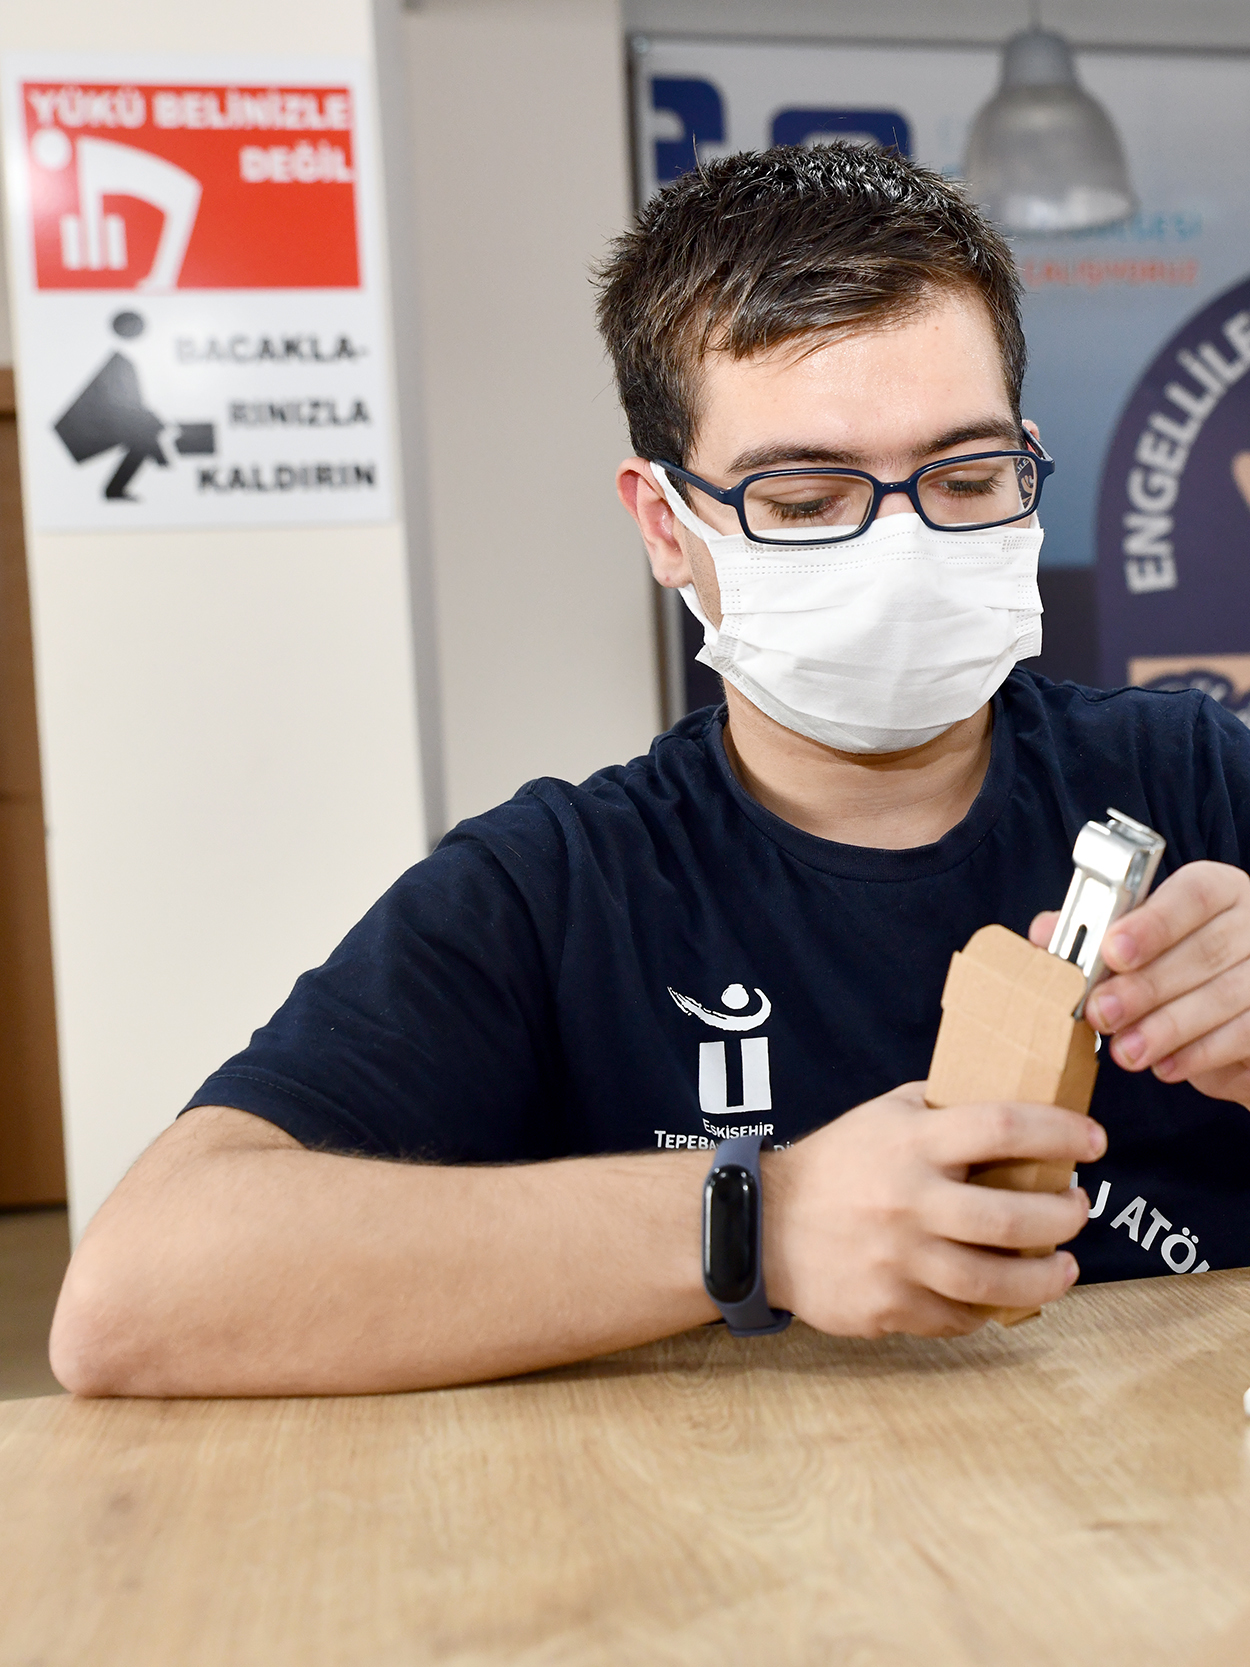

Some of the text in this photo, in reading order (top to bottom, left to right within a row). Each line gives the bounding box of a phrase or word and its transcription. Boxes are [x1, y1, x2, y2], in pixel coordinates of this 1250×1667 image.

[27, 85, 351, 130] YÜKÜ BELİNİZLE
[239, 138, 353, 183] DEĞİL
[197, 463, 376, 493] KALDIRIN
[654, 1129, 719, 1151] TEPEBA
